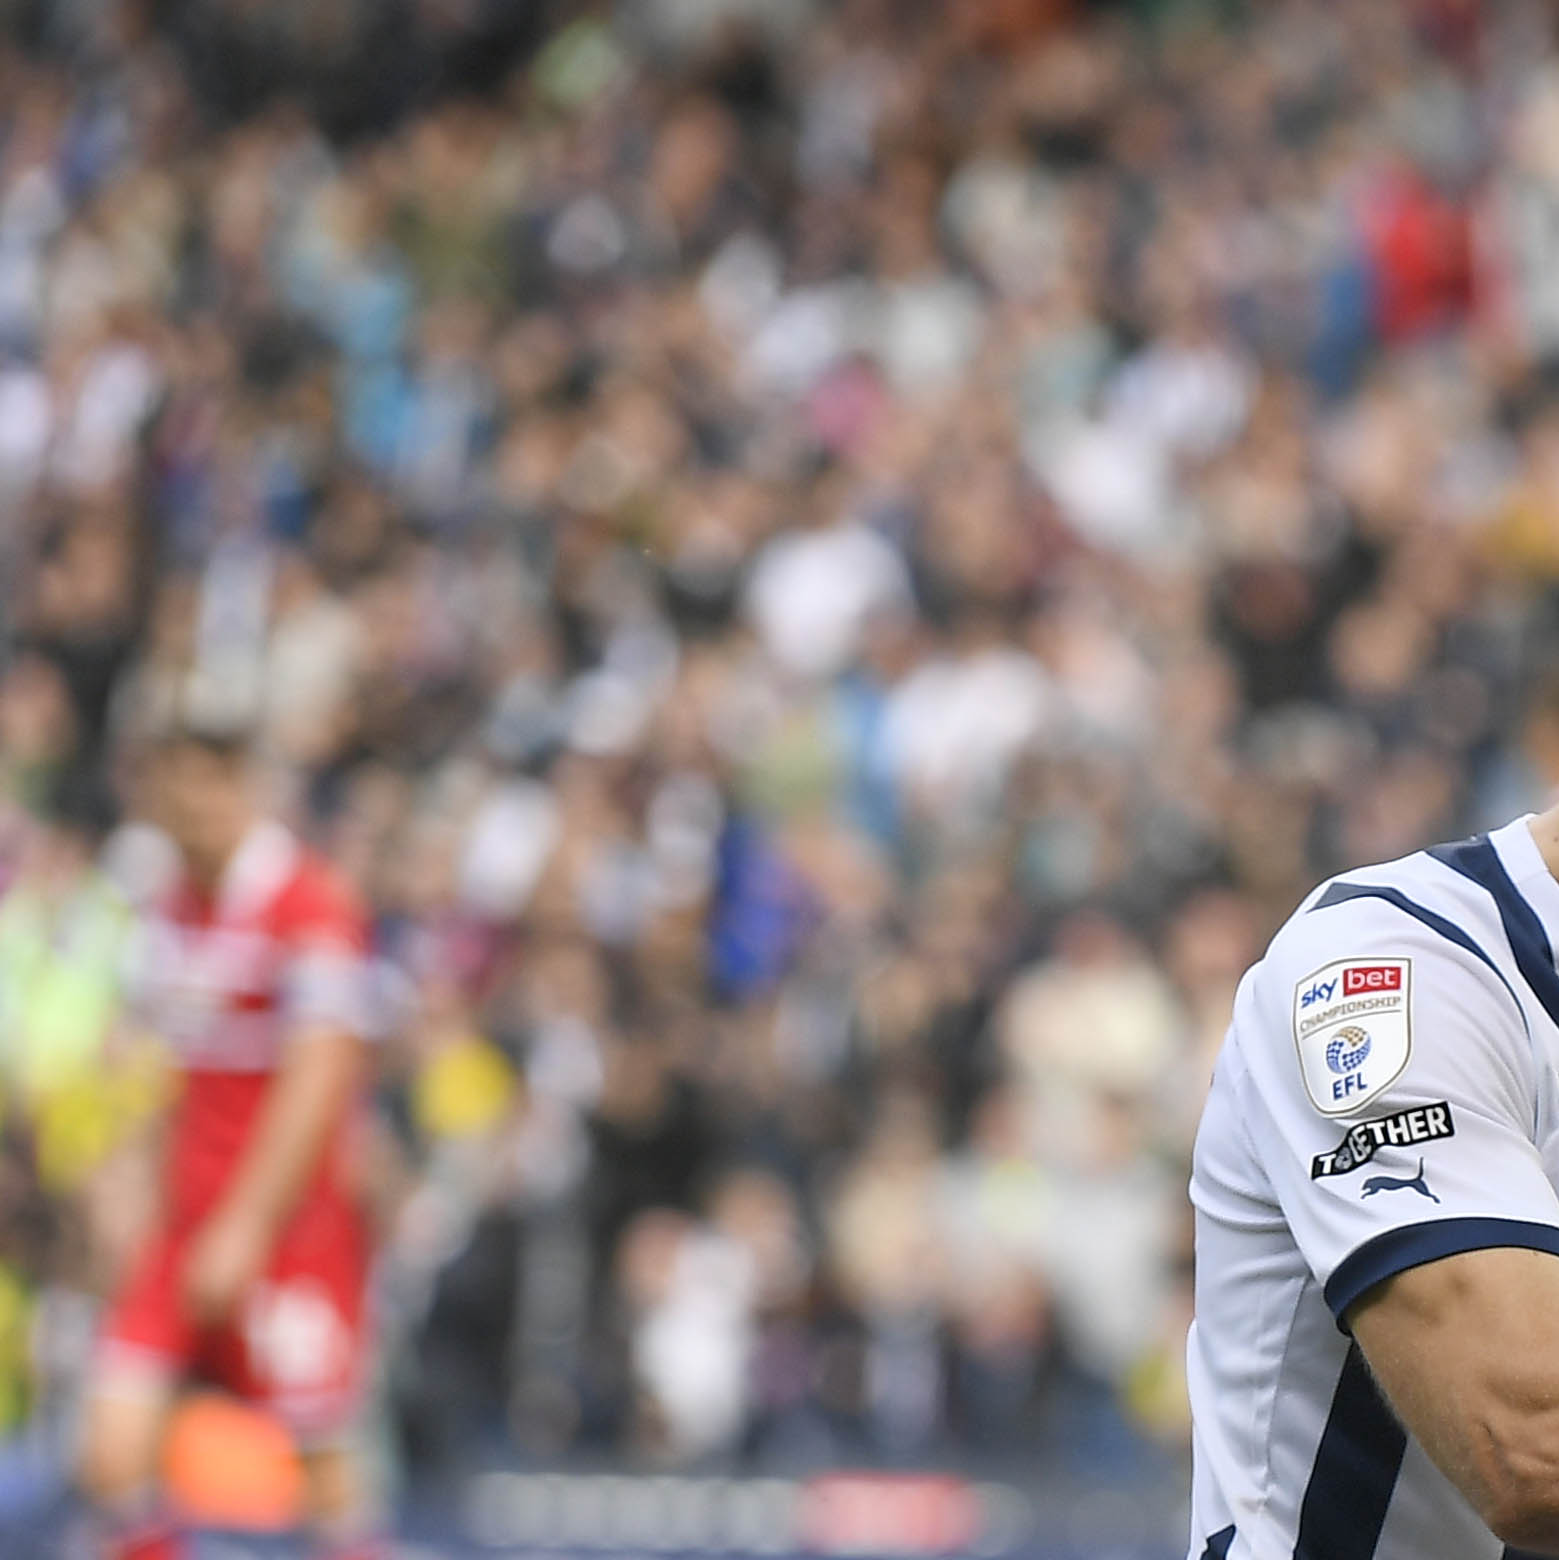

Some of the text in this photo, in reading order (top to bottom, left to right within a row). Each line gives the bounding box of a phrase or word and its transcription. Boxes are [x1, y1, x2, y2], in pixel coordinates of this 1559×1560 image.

[1301, 968, 1397, 1008] sky bet
[1332, 1072, 1368, 1100] EFL
